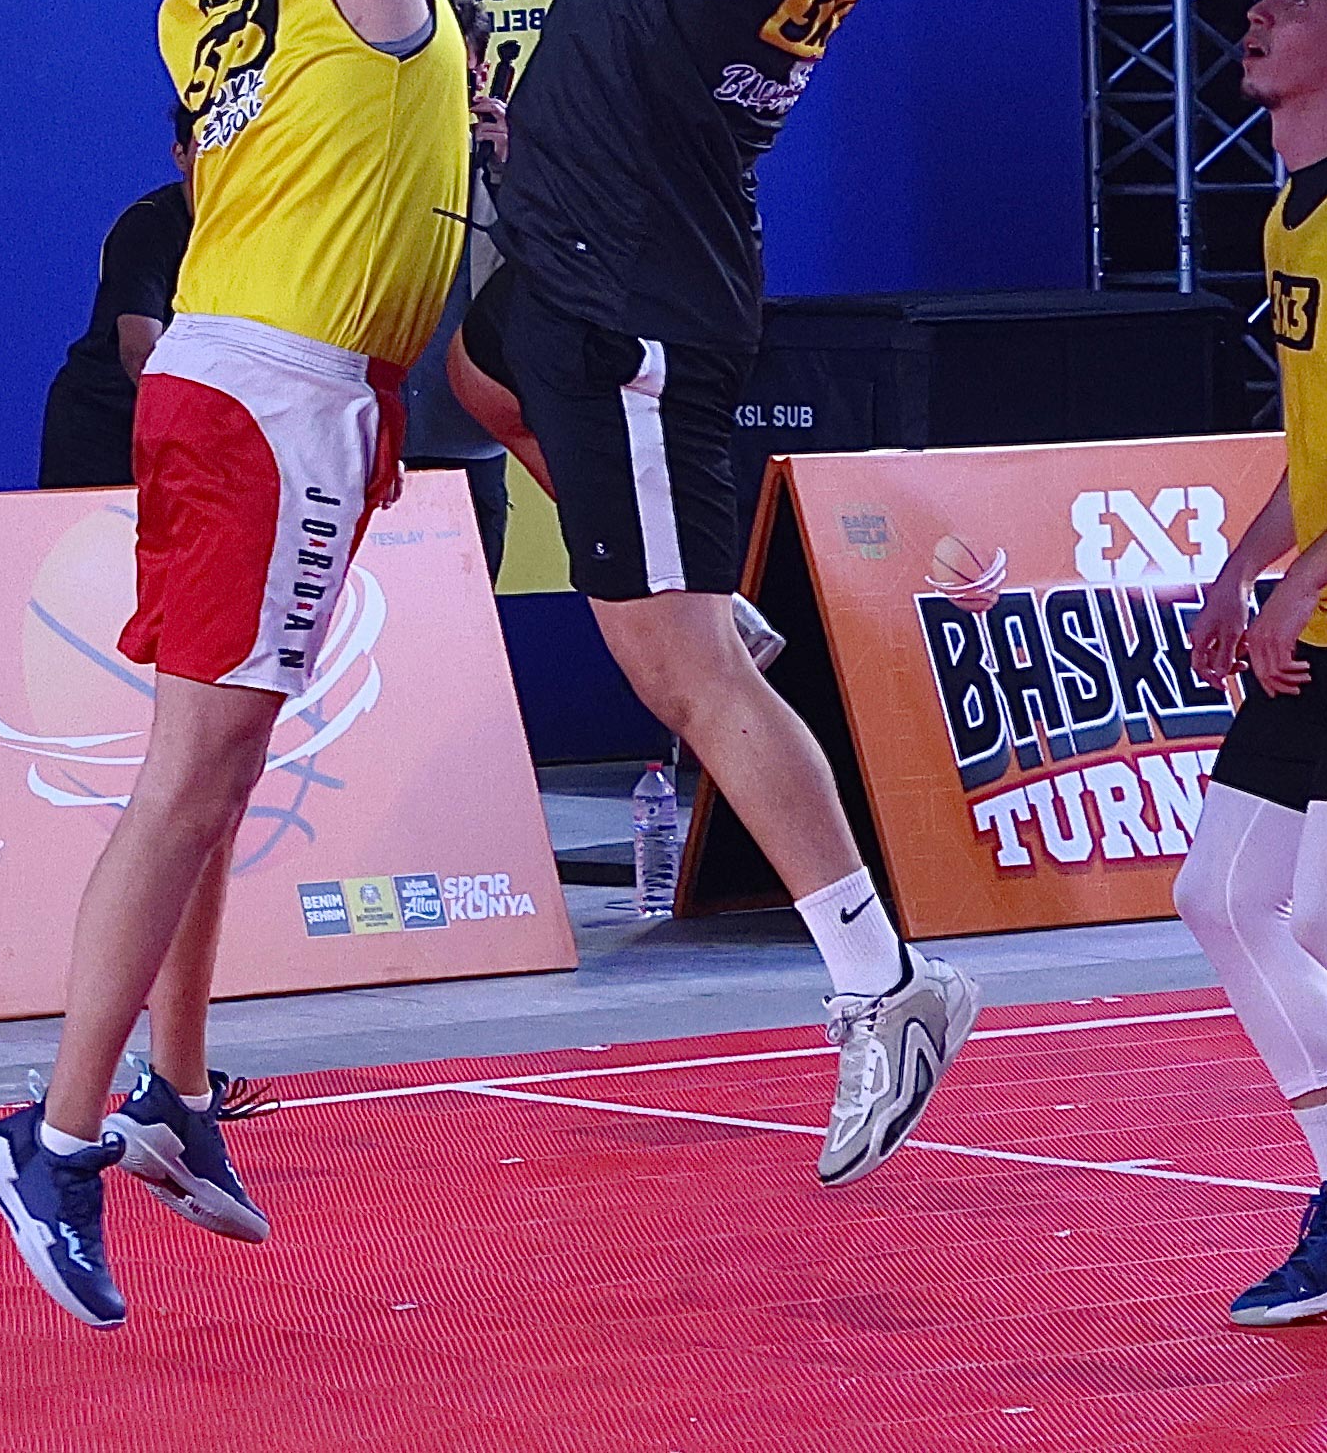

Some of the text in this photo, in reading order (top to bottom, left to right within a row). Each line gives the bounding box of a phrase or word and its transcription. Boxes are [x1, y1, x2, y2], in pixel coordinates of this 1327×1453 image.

[773, 405, 813, 427] SUB
[278, 486, 341, 669] JORDAN
[443, 873, 511, 899] SPOR
[450, 892, 537, 921] KONYA
